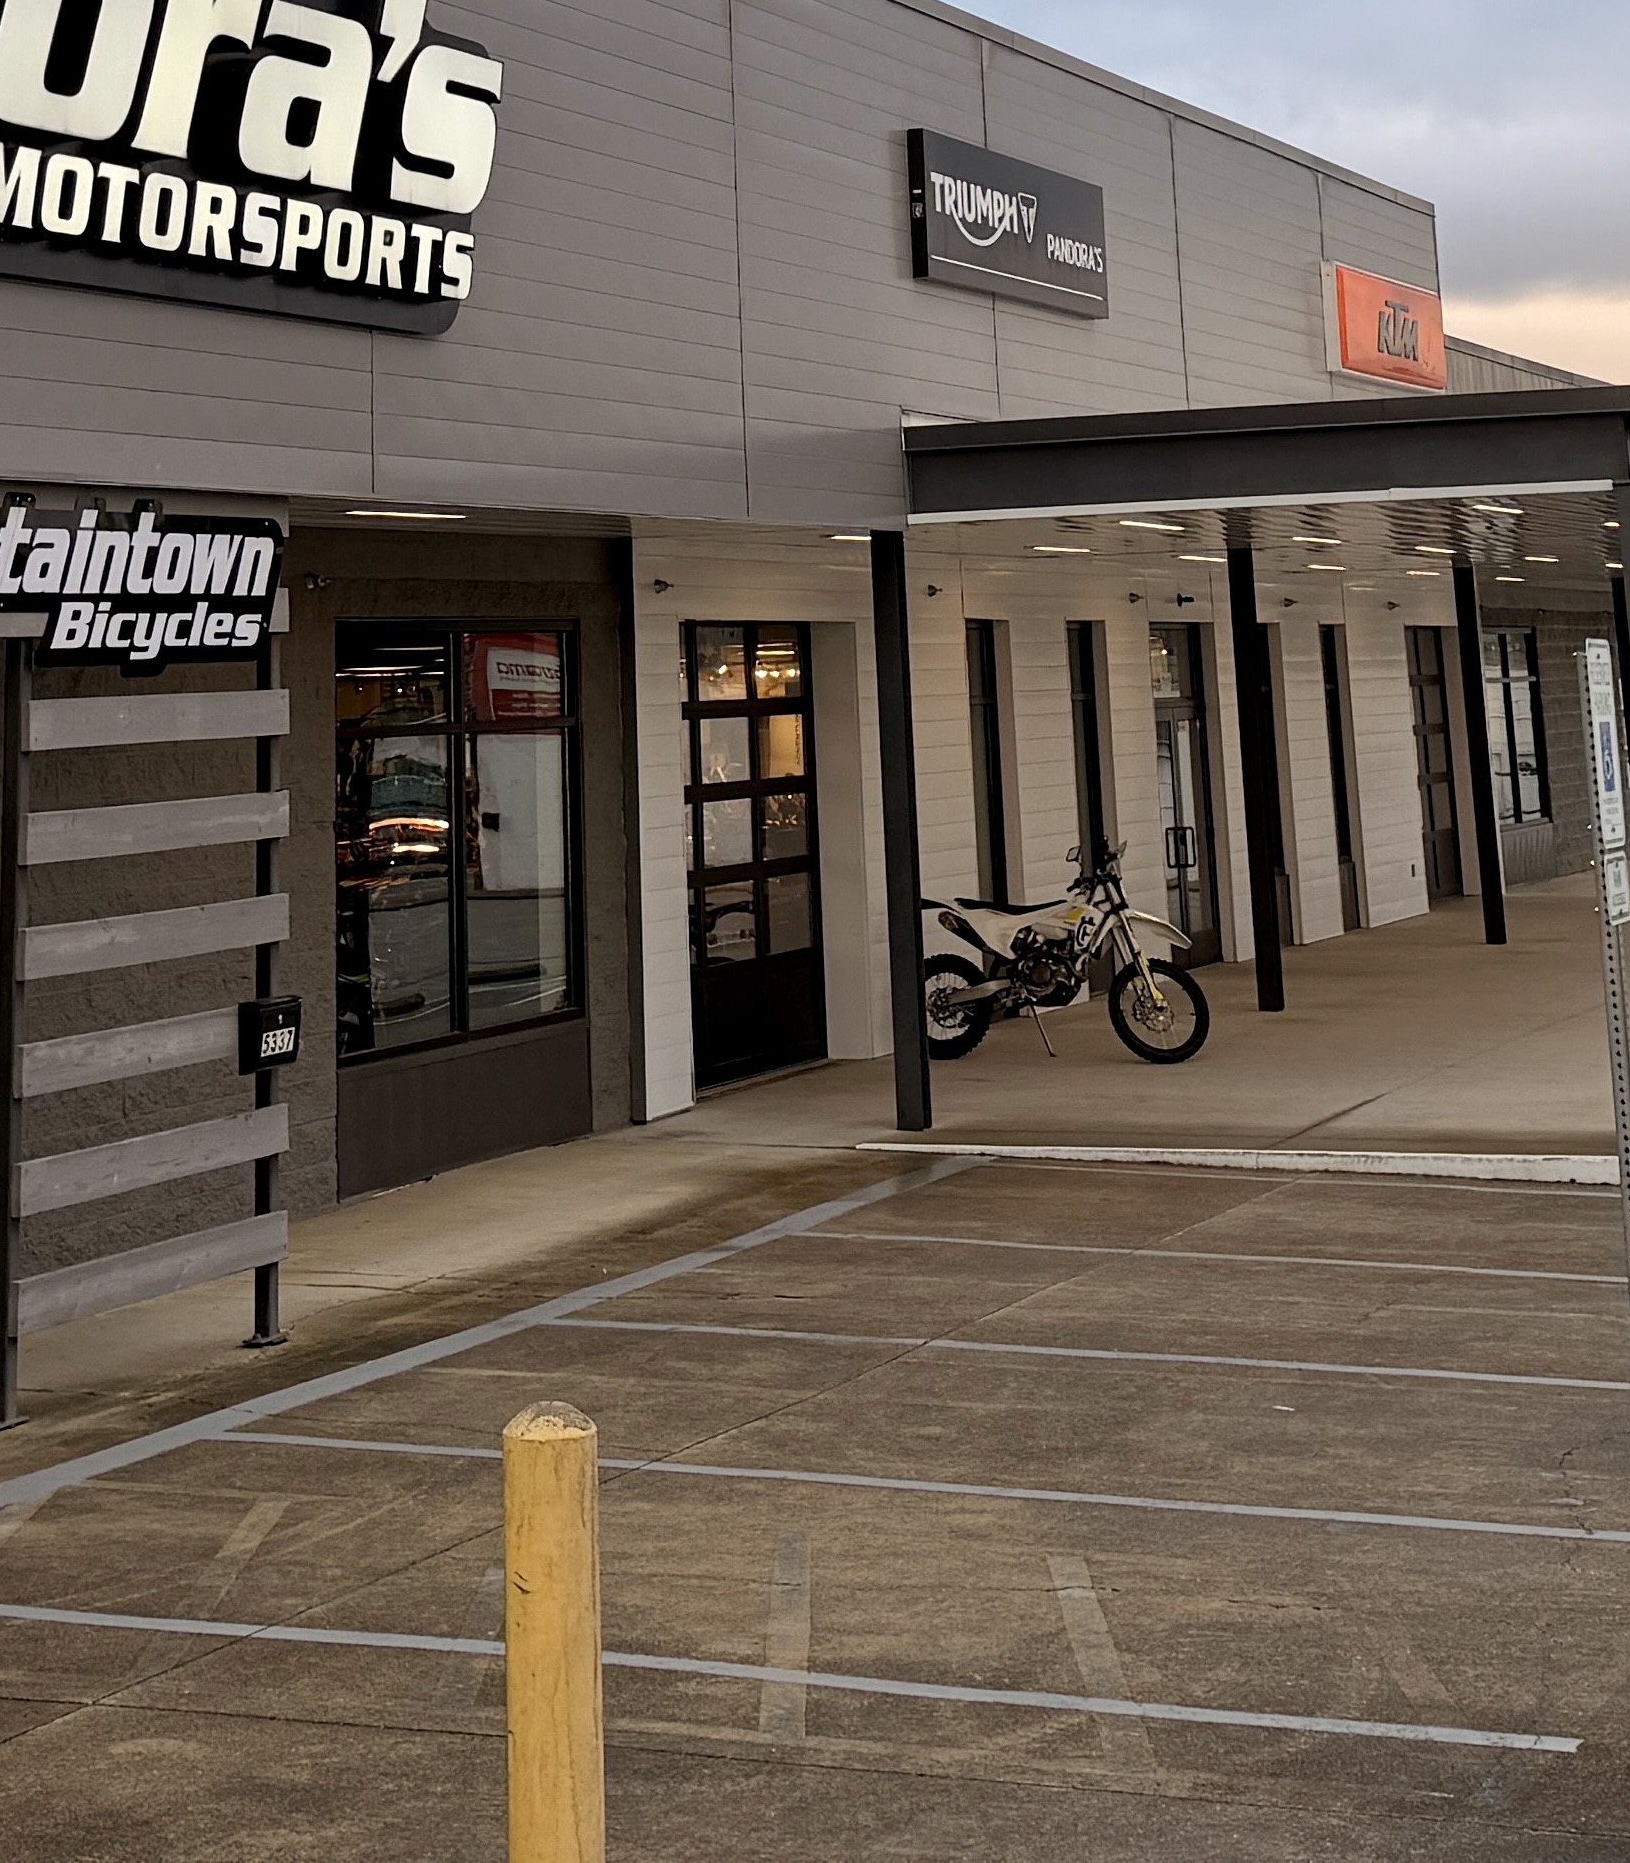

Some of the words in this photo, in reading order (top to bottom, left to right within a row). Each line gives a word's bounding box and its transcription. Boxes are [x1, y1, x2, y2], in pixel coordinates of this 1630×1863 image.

[930, 171, 1019, 247] TRIUMPH
[1046, 233, 1104, 273] PANDORA'S
[1377, 299, 1419, 362] KTM
[50, 600, 261, 661] Bicycles
[262, 1029, 294, 1055] 5337
